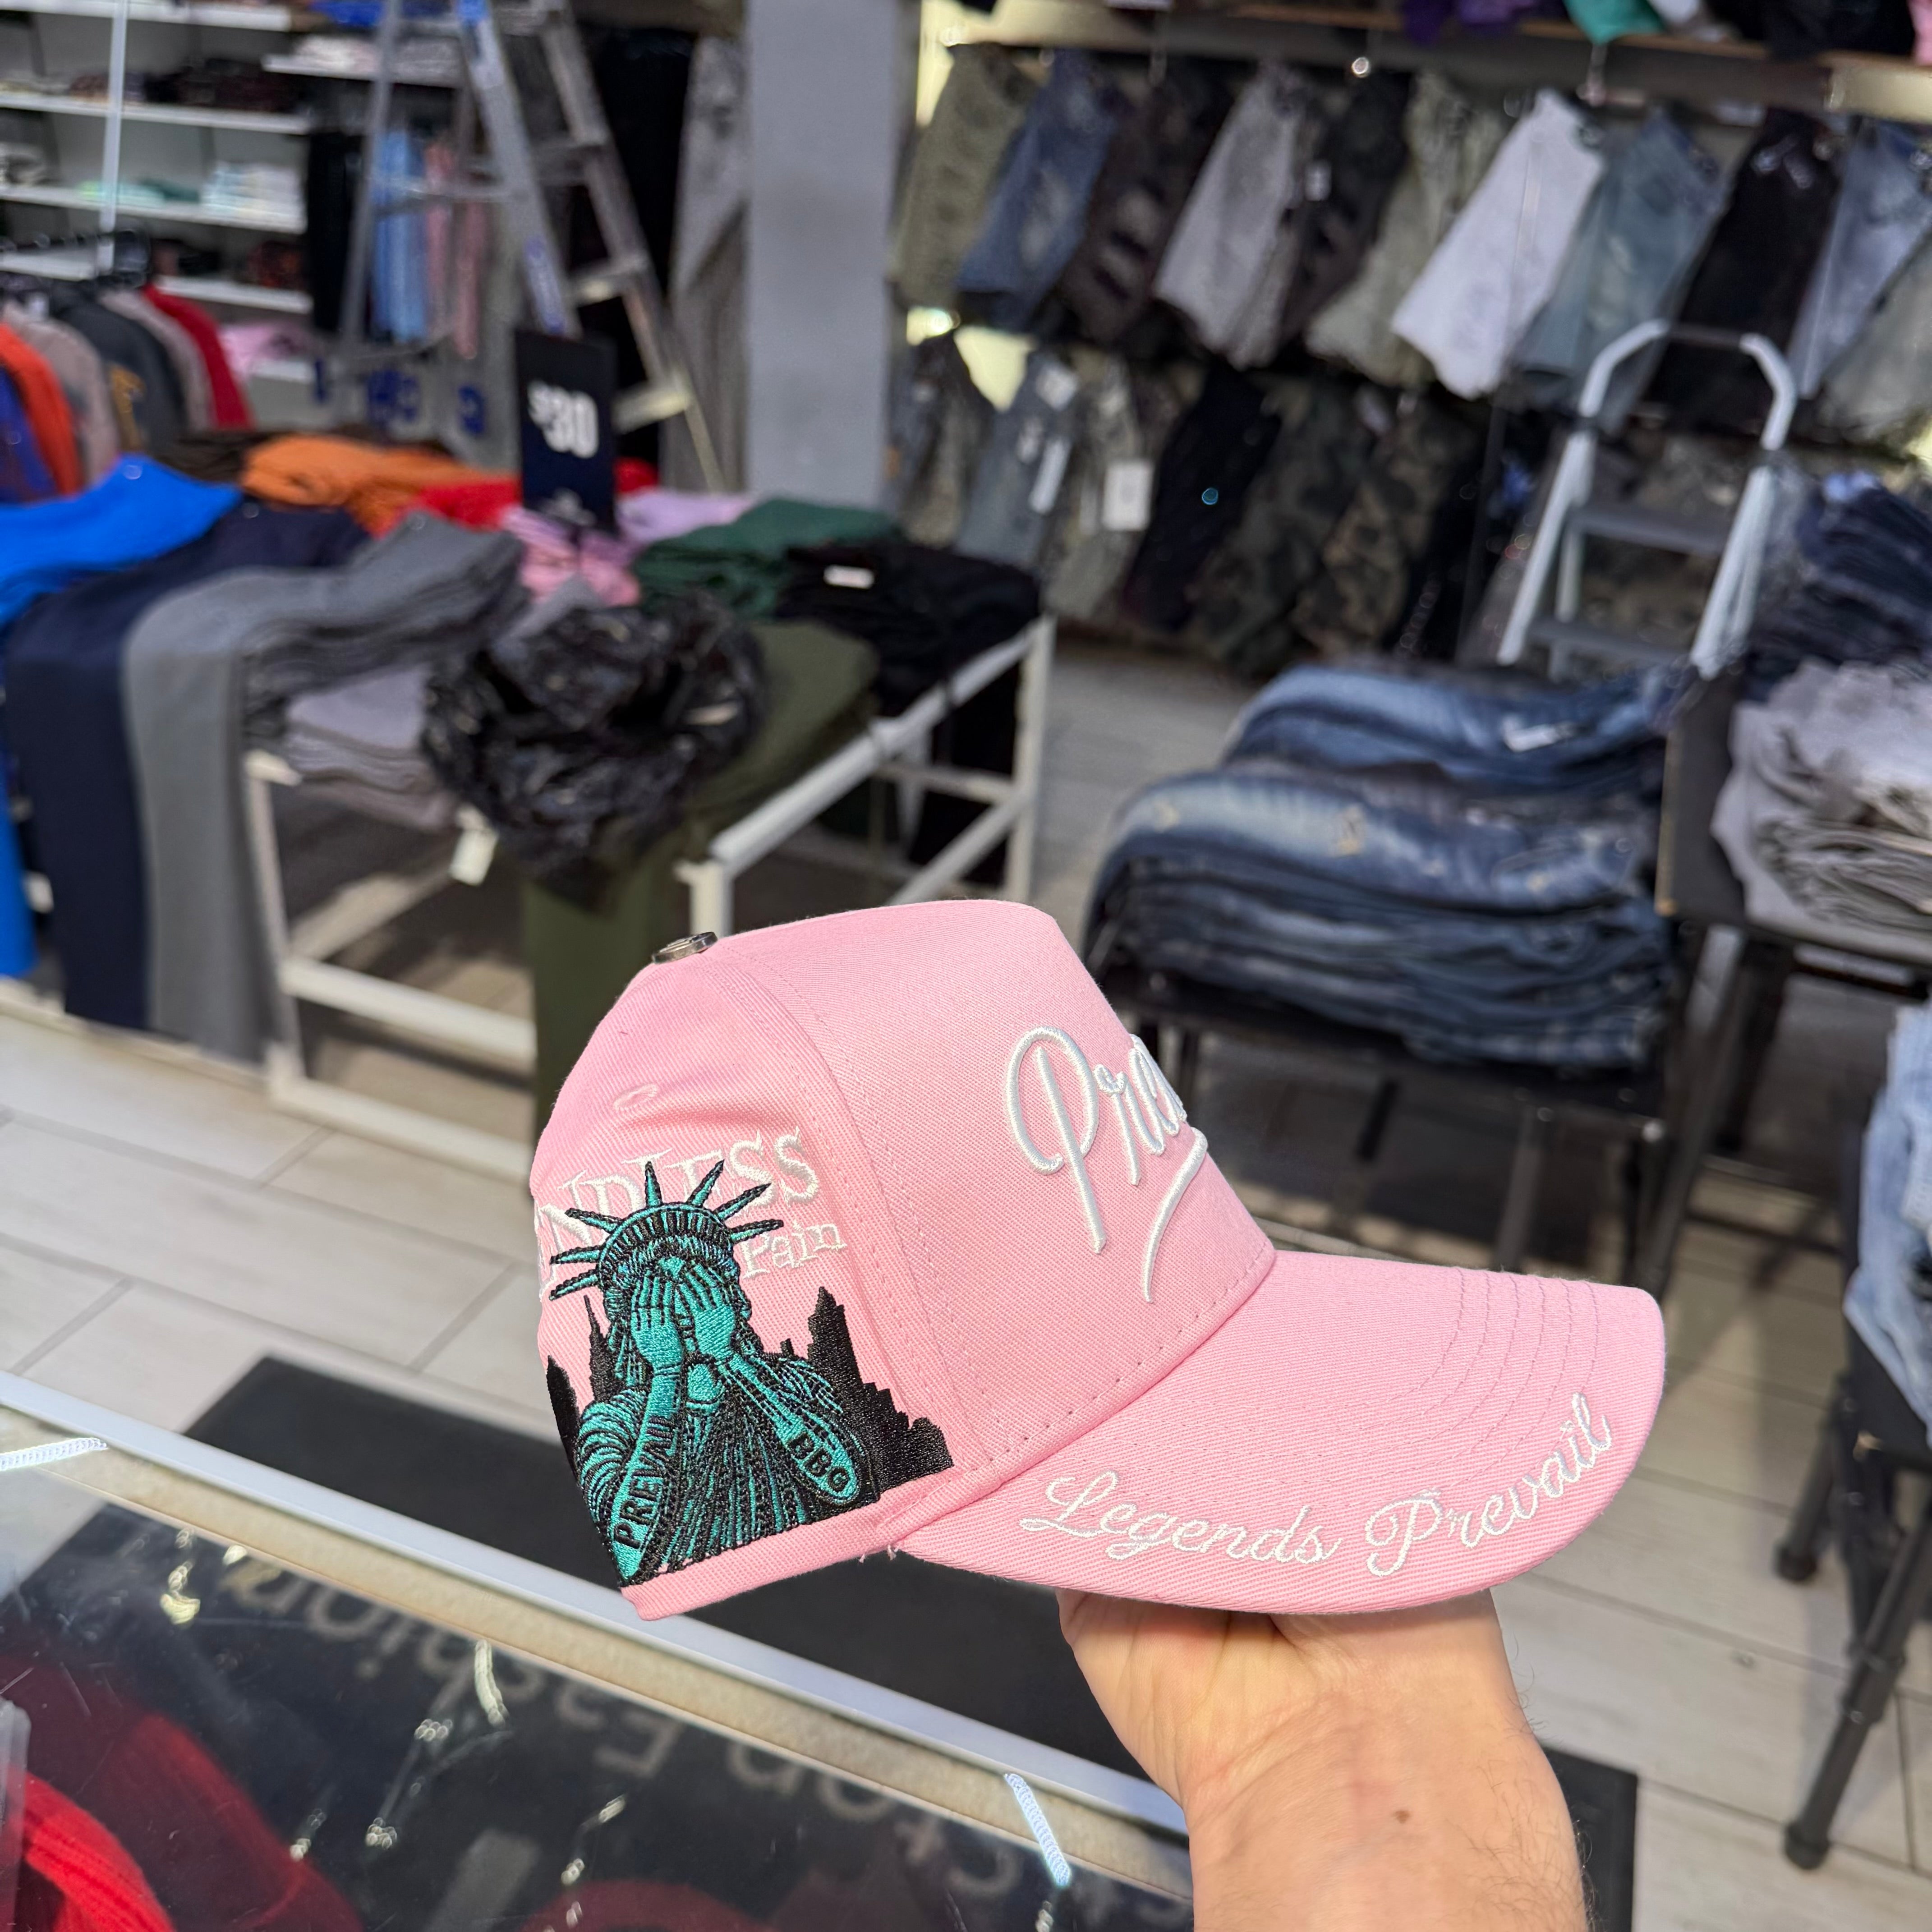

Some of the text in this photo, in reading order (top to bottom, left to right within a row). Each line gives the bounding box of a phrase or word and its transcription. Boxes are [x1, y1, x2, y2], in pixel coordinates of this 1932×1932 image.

[528, 378, 599, 458] $30
[1019, 1392, 1612, 1577] Legends Prevail
